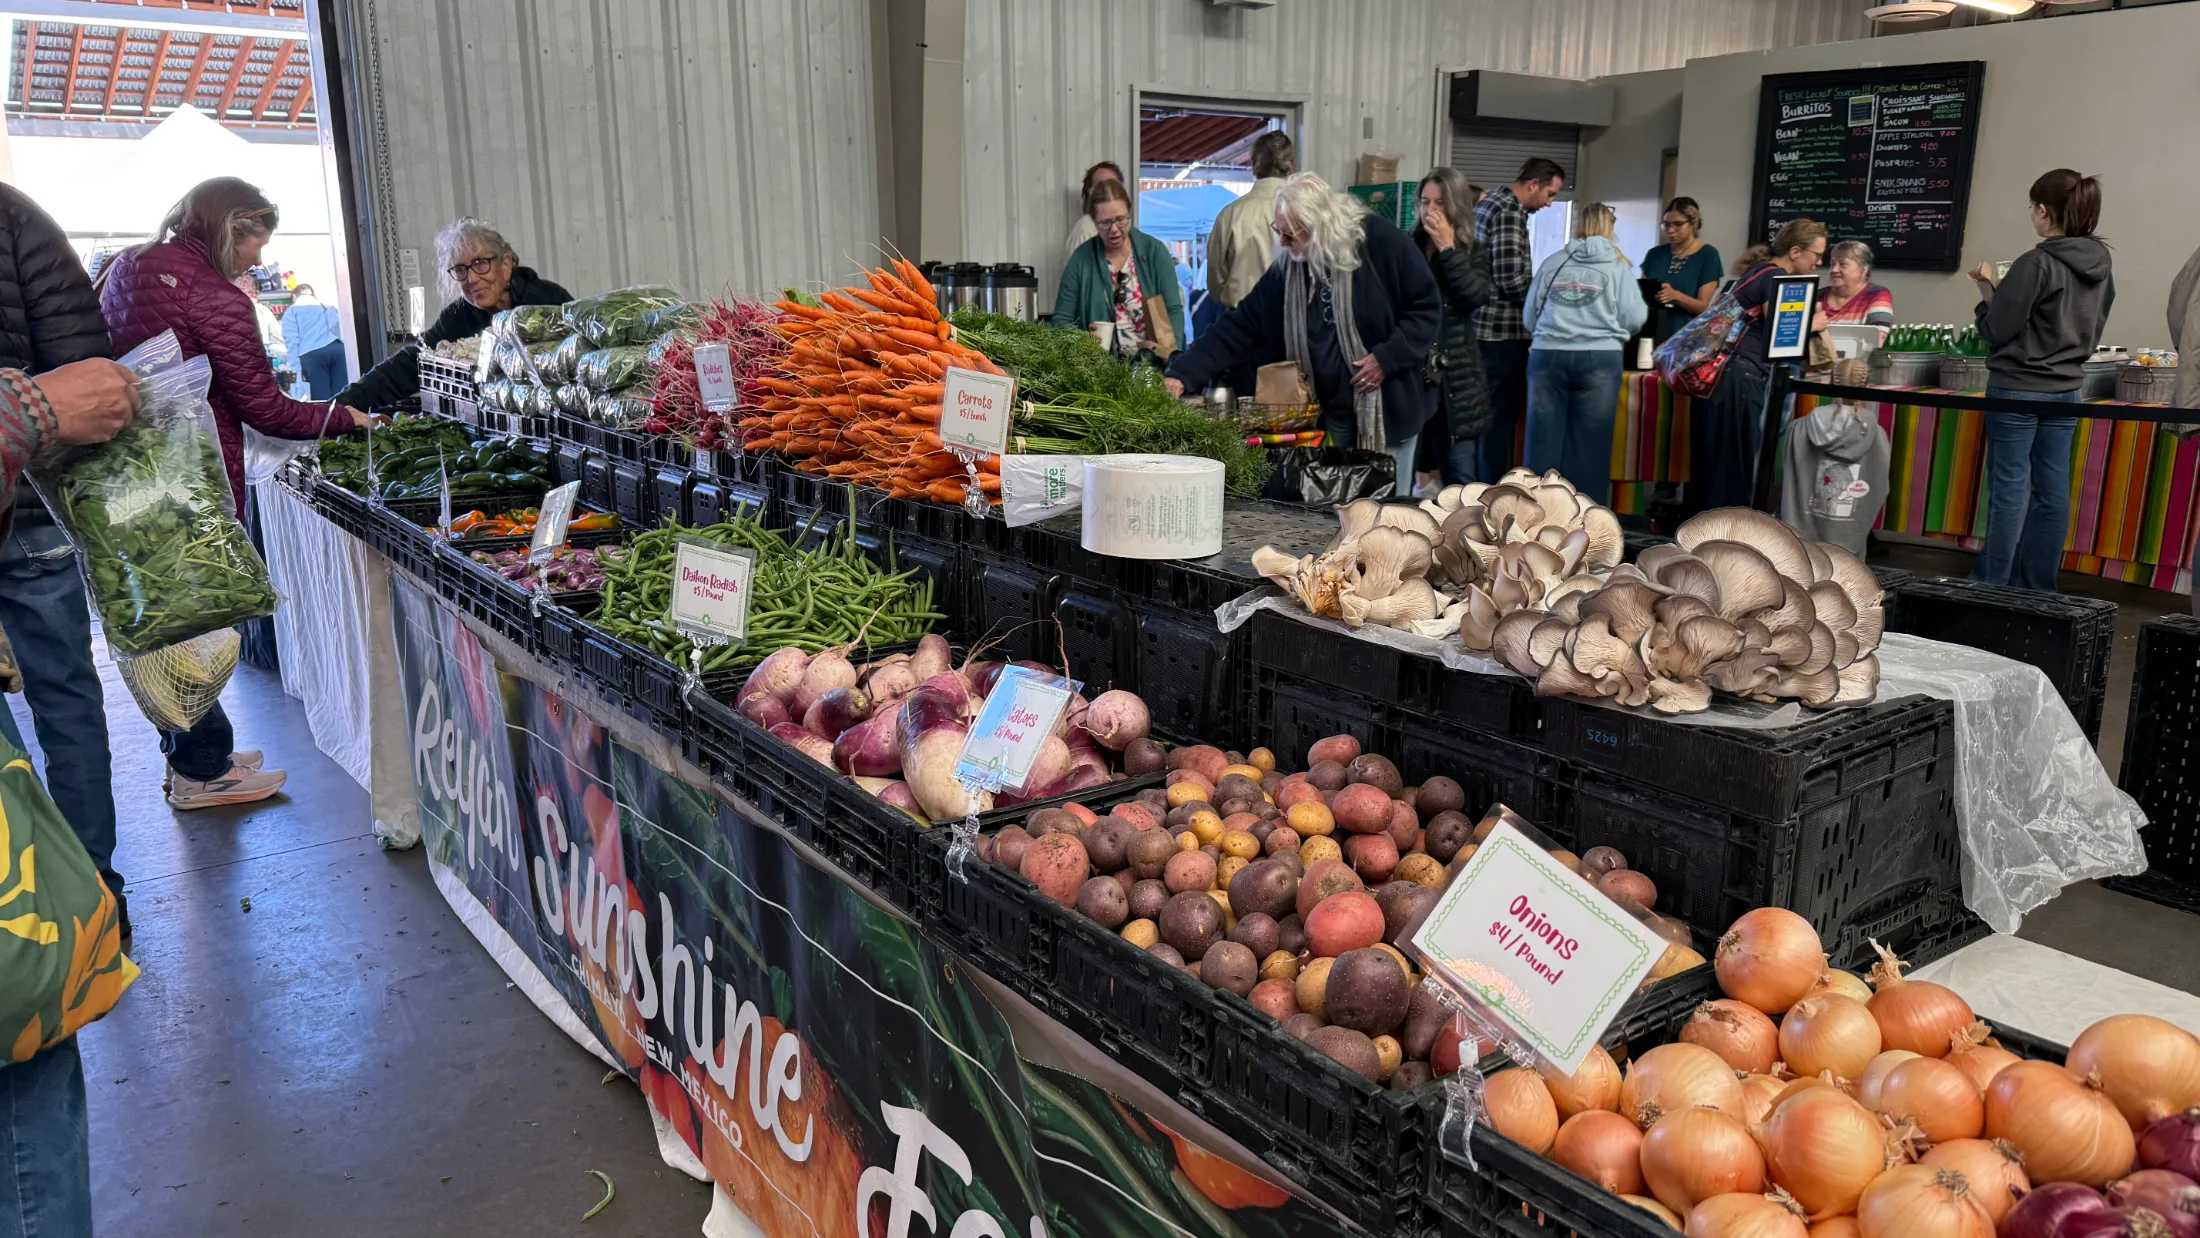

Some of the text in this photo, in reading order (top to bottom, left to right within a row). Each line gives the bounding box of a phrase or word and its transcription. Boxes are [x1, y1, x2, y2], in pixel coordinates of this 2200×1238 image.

[957, 389, 993, 410] Carrots
[1005, 479, 1013, 504] OPEN
[1048, 468, 1059, 500] more
[682, 566, 738, 593] Daikon Radish
[1587, 728, 1618, 748] 6425
[1509, 895, 1579, 961] Onions
[534, 795, 814, 1162] Sunshine
[635, 1022, 674, 1072] NEW
[679, 1062, 743, 1150] MEXICO
